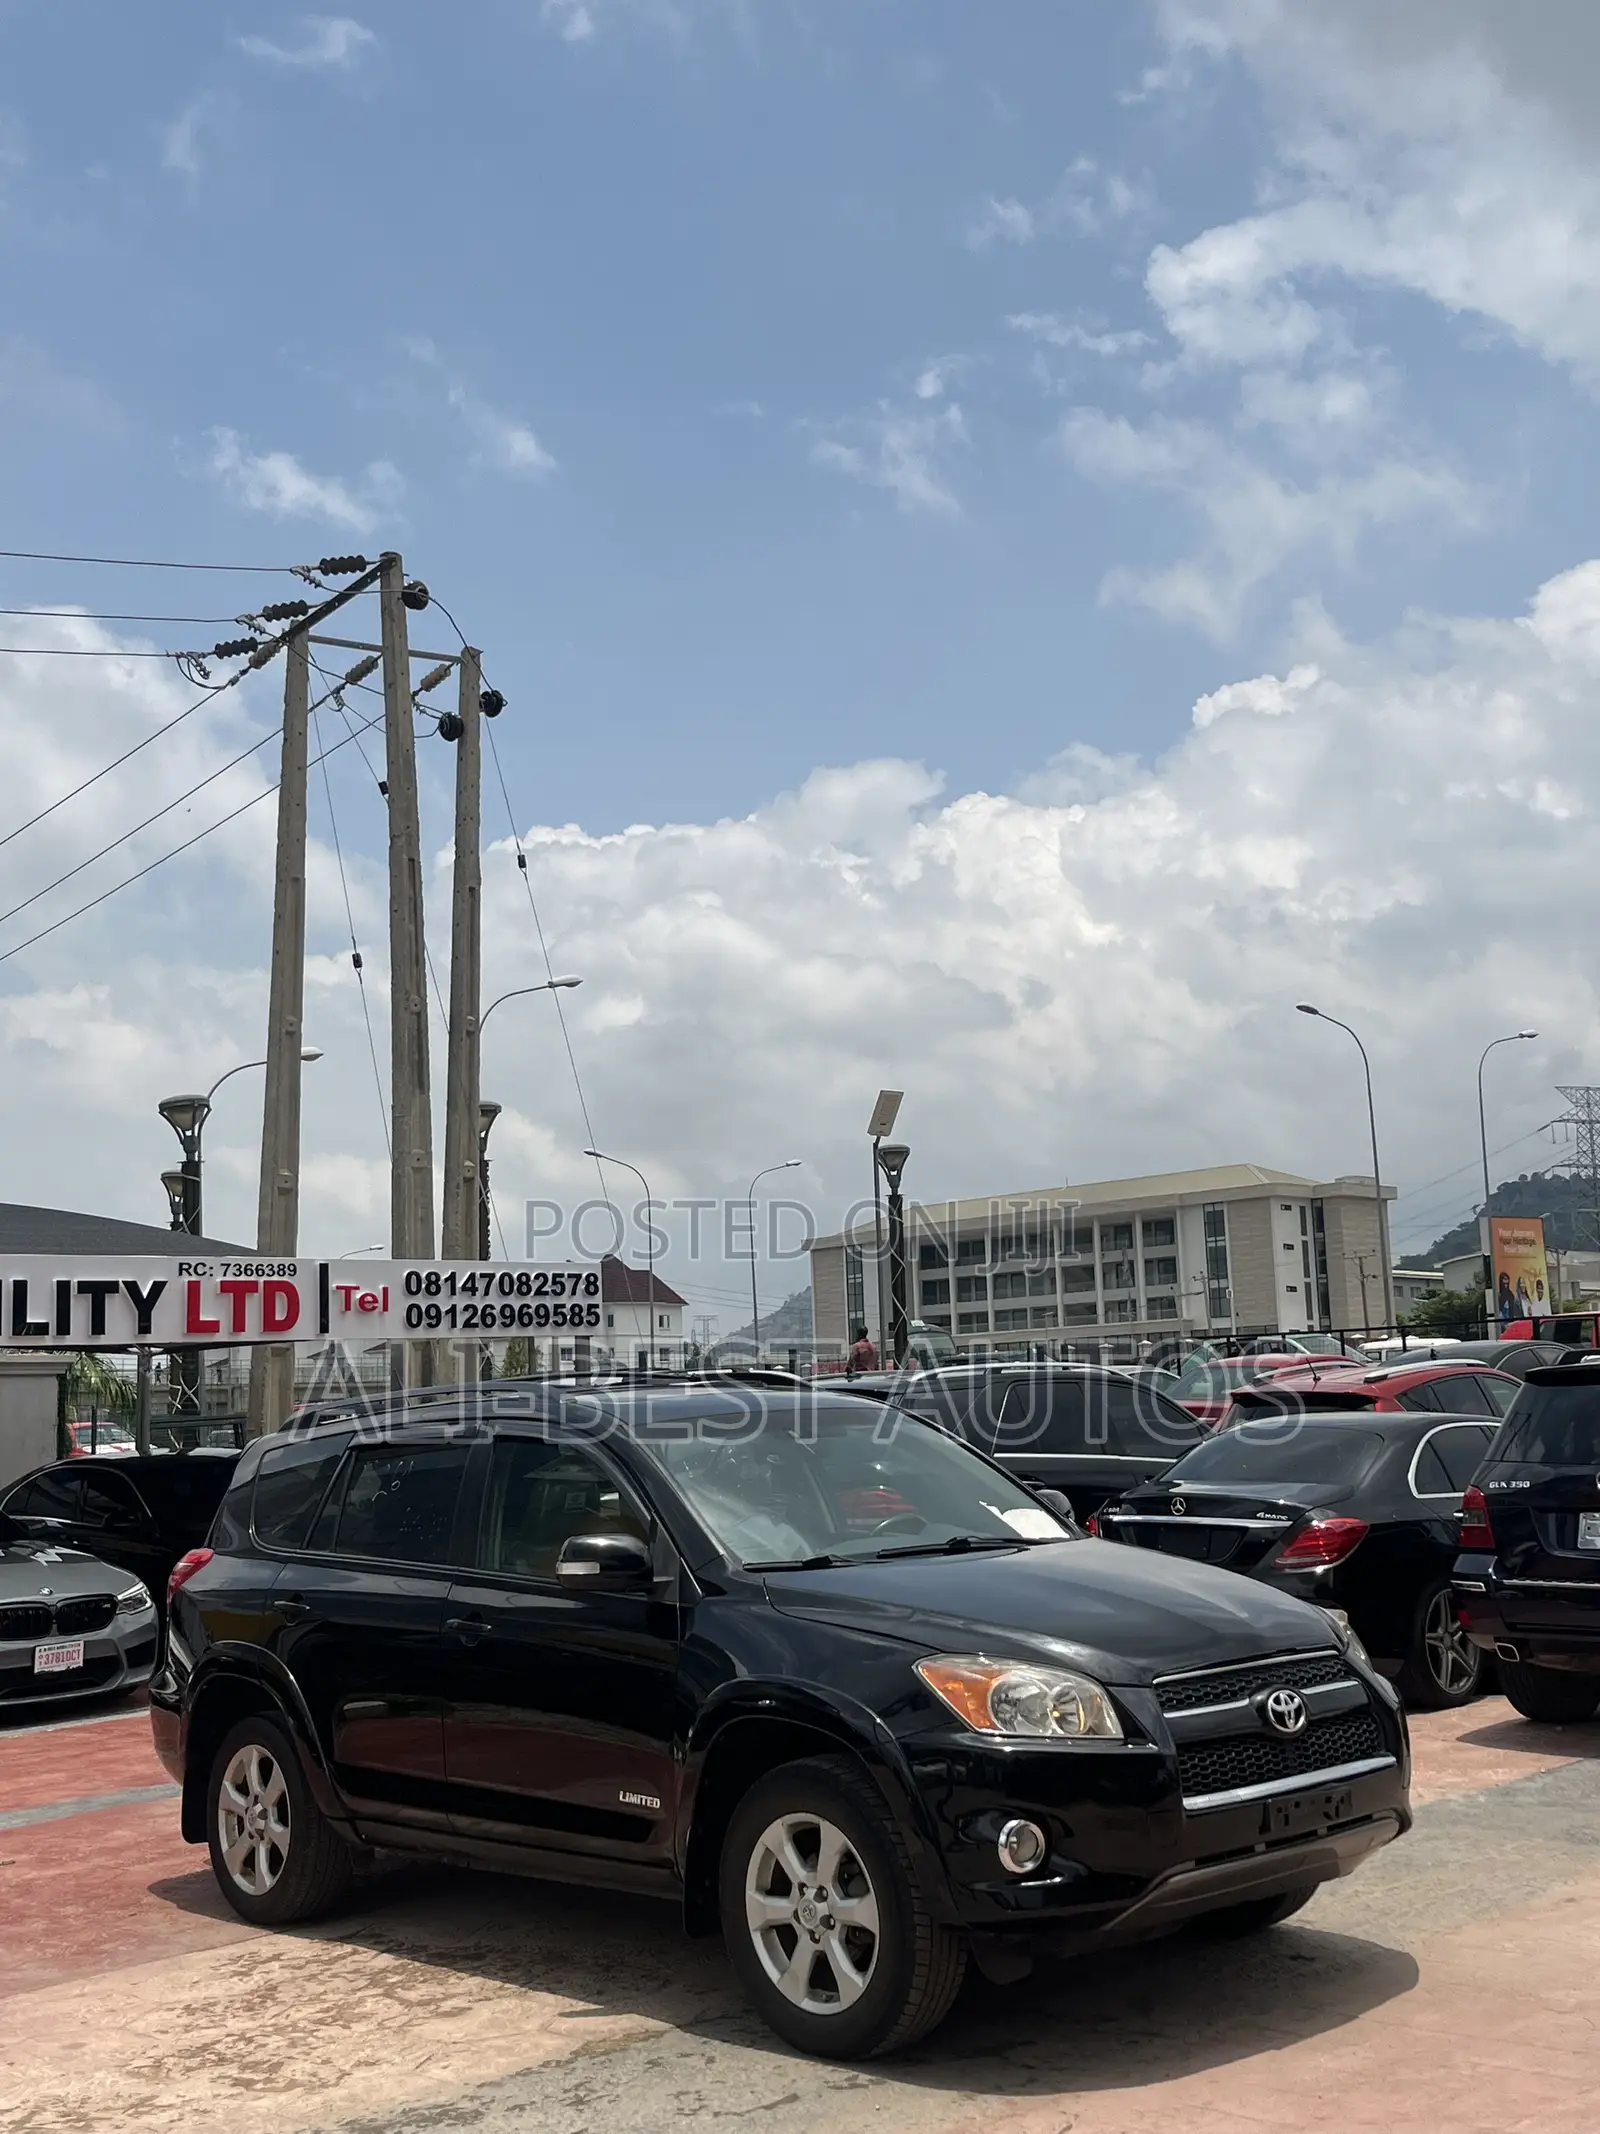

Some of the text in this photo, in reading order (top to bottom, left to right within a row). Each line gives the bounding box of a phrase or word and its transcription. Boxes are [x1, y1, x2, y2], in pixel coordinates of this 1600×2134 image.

[178, 1262, 297, 1277] RC: 7366389
[405, 1271, 600, 1297] 08147082578
[0, 1279, 300, 1336] LITY LTD
[335, 1285, 389, 1313] Tel
[406, 1303, 600, 1329] 09126969585
[618, 1790, 661, 1809] LIMITED
